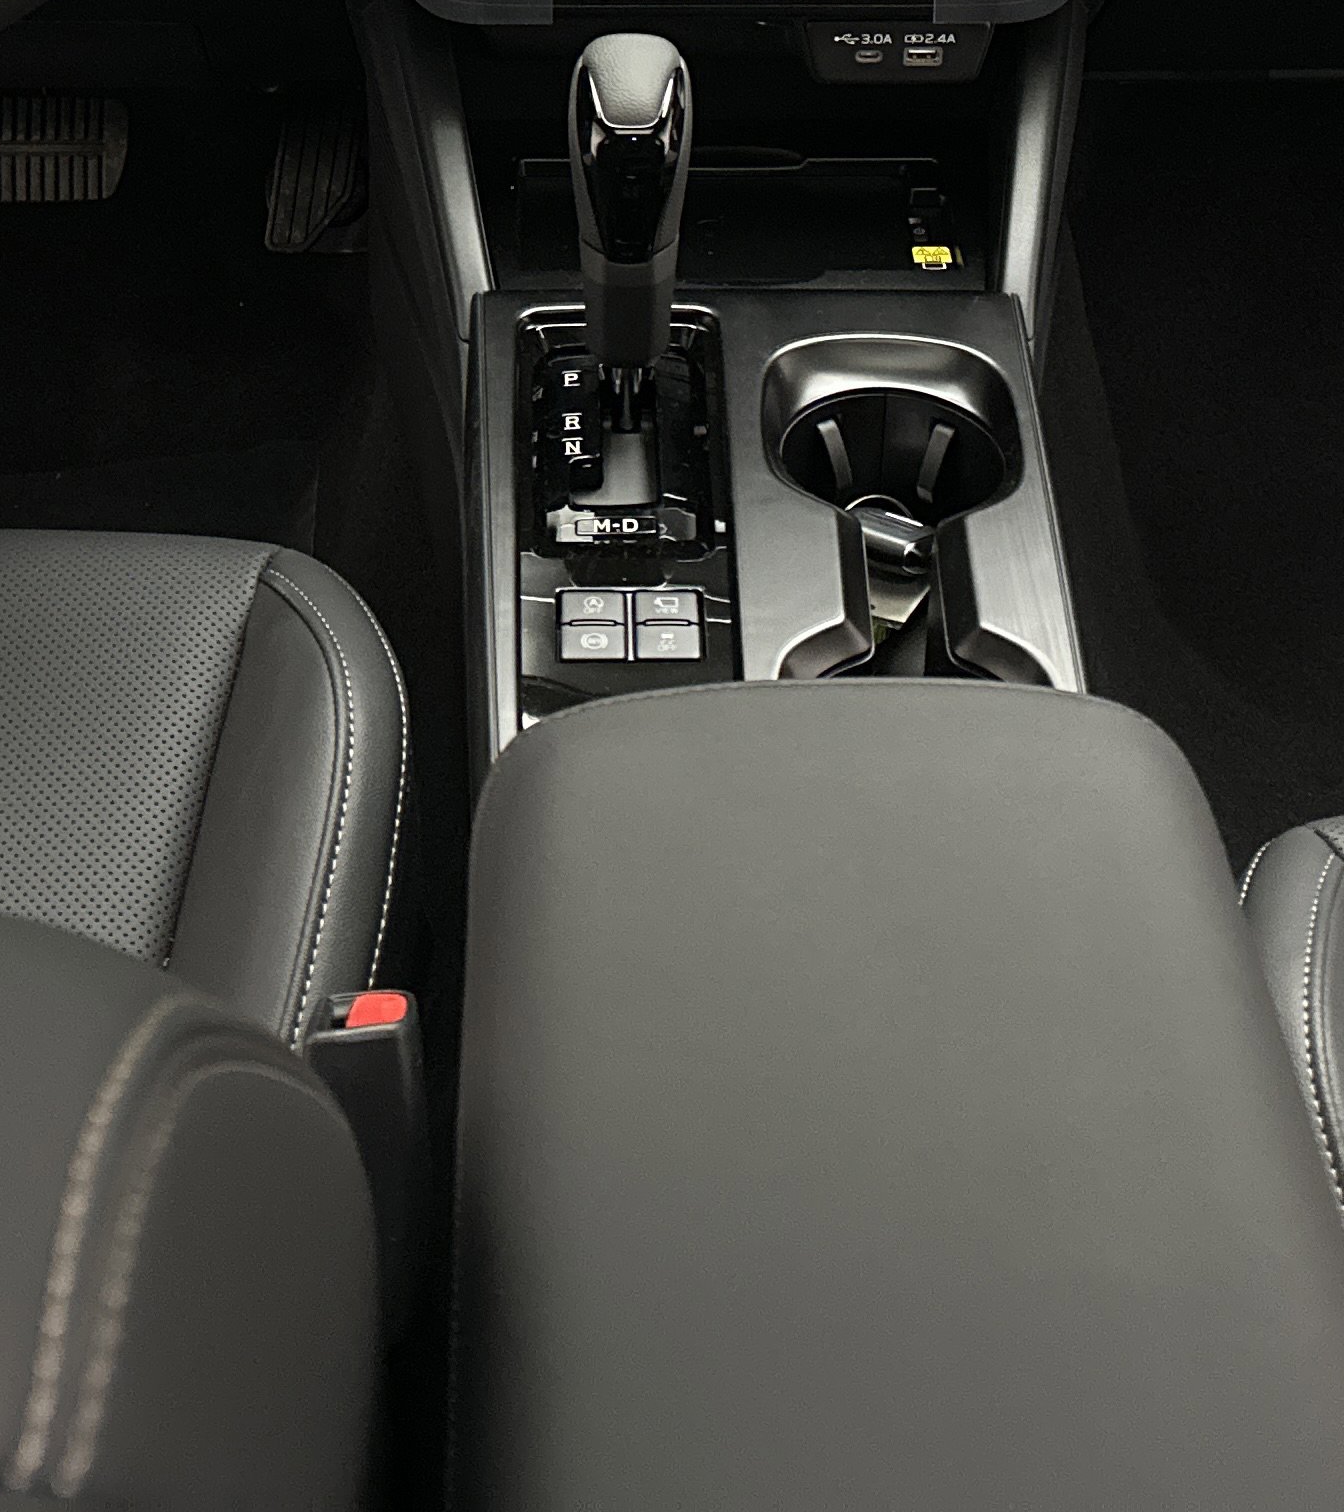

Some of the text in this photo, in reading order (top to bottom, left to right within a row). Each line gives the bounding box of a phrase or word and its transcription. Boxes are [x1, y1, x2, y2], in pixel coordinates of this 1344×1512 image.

[861, 34, 892, 45] 3.0A
[925, 34, 956, 45] 2.4A
[563, 372, 580, 387] P
[563, 415, 581, 430] R
[564, 440, 582, 455] N
